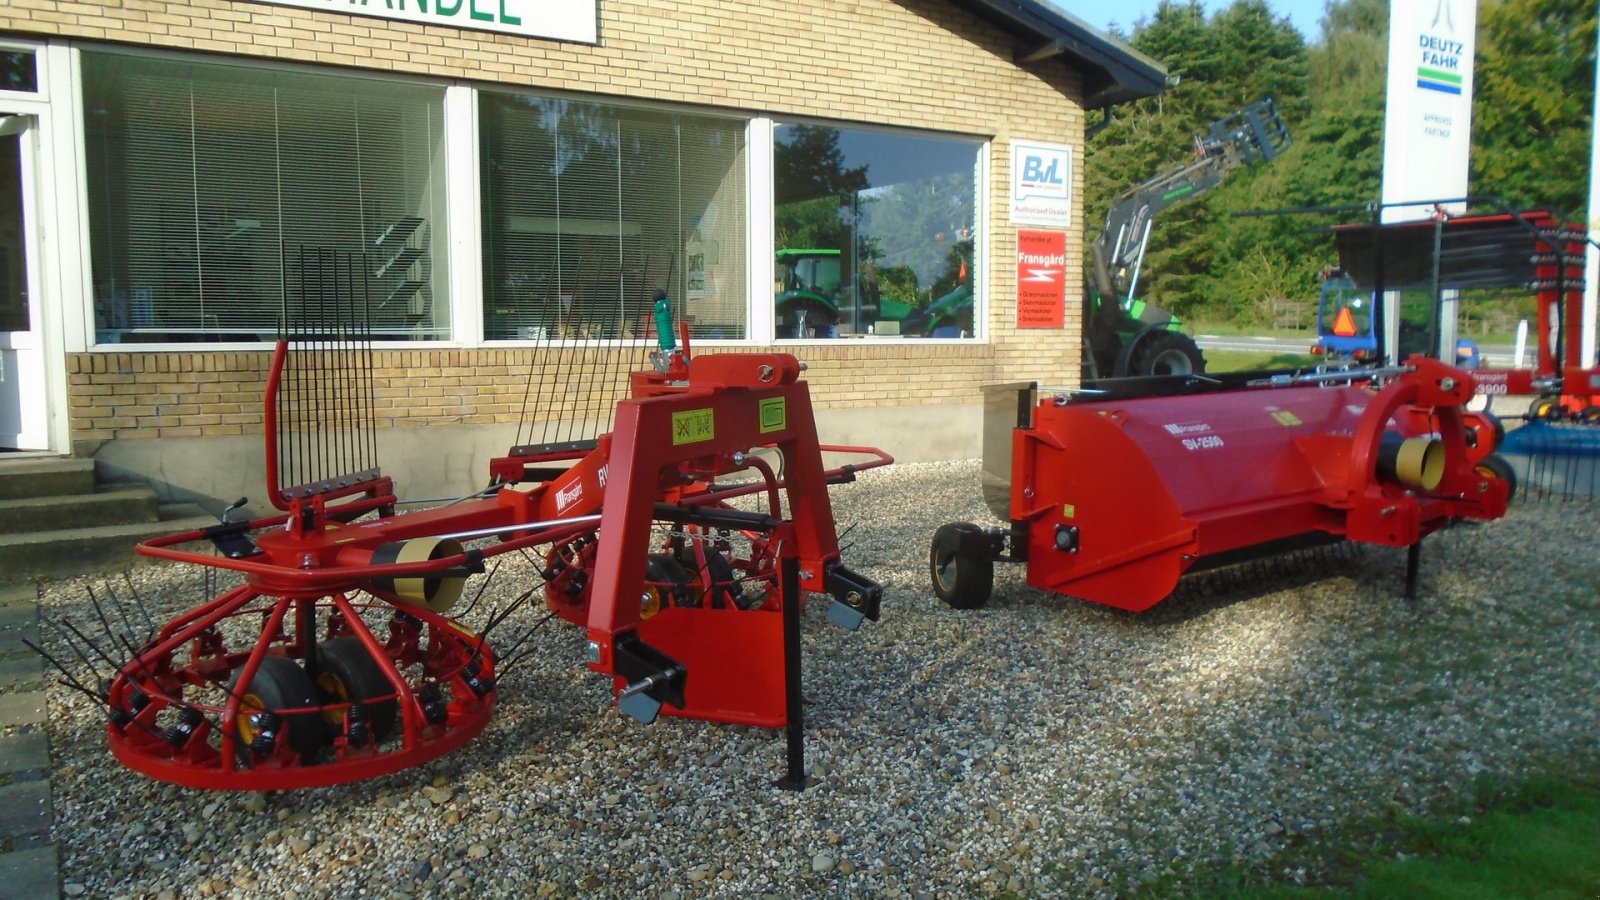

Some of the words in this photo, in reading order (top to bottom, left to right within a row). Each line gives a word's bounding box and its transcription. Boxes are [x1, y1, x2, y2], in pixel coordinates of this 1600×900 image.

[1419, 34, 1464, 55] DEUTZ
[1423, 52, 1459, 69] FAHR
[1015, 205, 1048, 215] Authorized
[1049, 207, 1068, 216] Dealer
[1018, 252, 1064, 267] Fransgård
